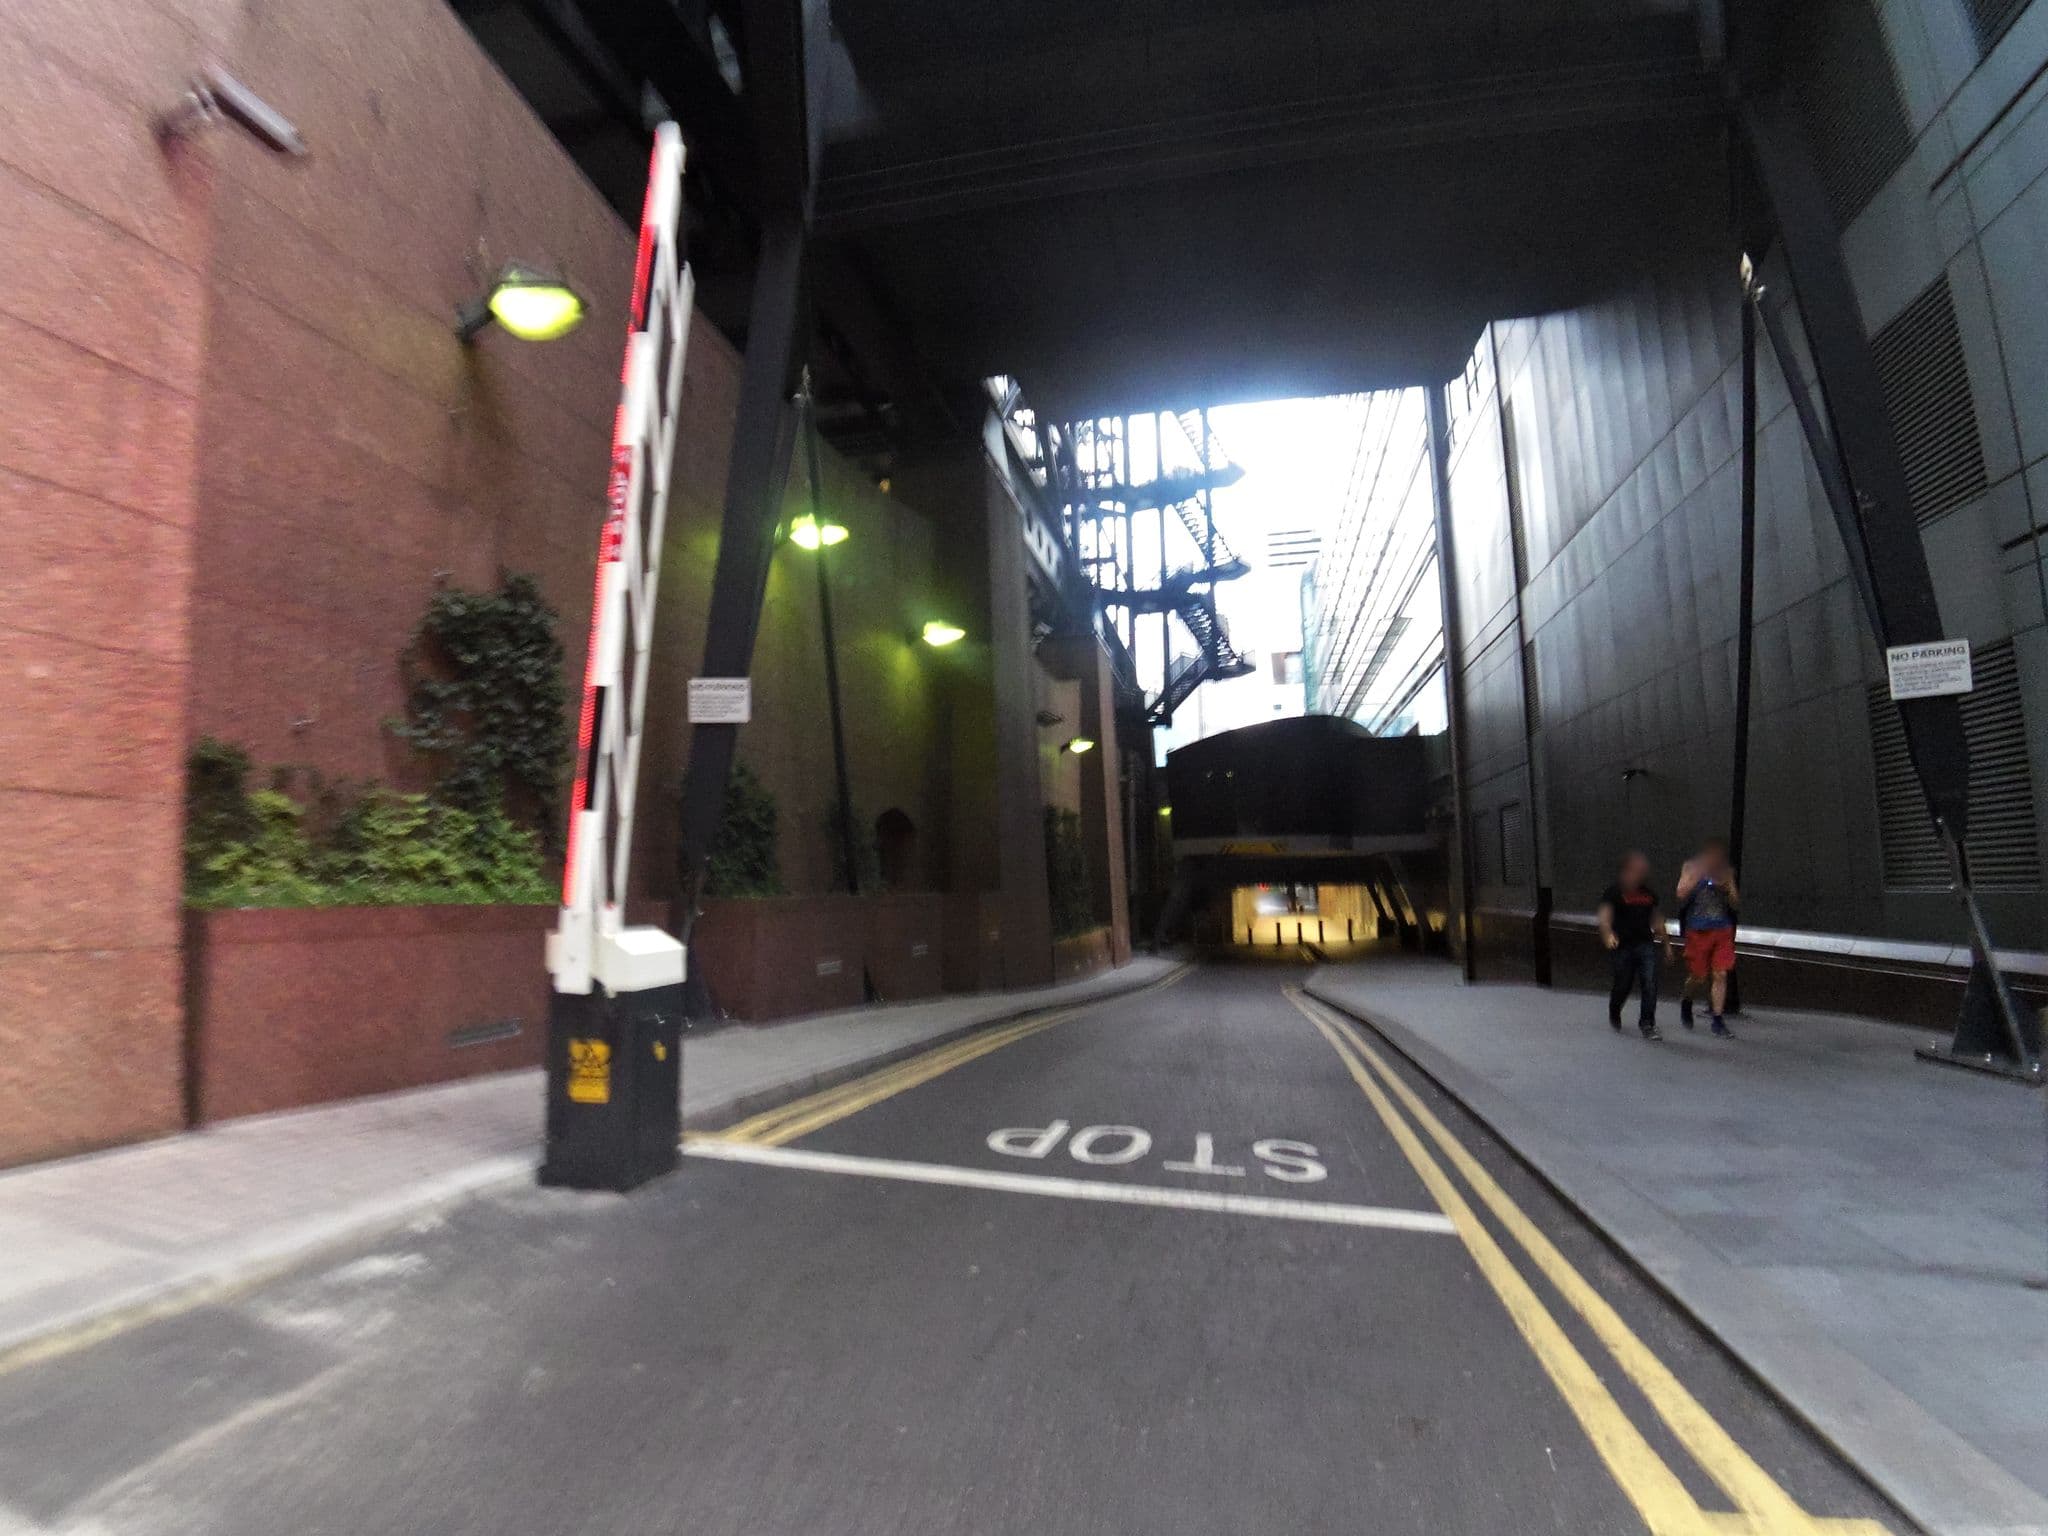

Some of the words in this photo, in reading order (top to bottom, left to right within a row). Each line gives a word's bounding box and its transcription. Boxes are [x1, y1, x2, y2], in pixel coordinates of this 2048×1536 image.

[1891, 653, 1909, 662] NO
[1912, 646, 1966, 659] PARKING
[986, 1119, 1328, 1183] STOP
